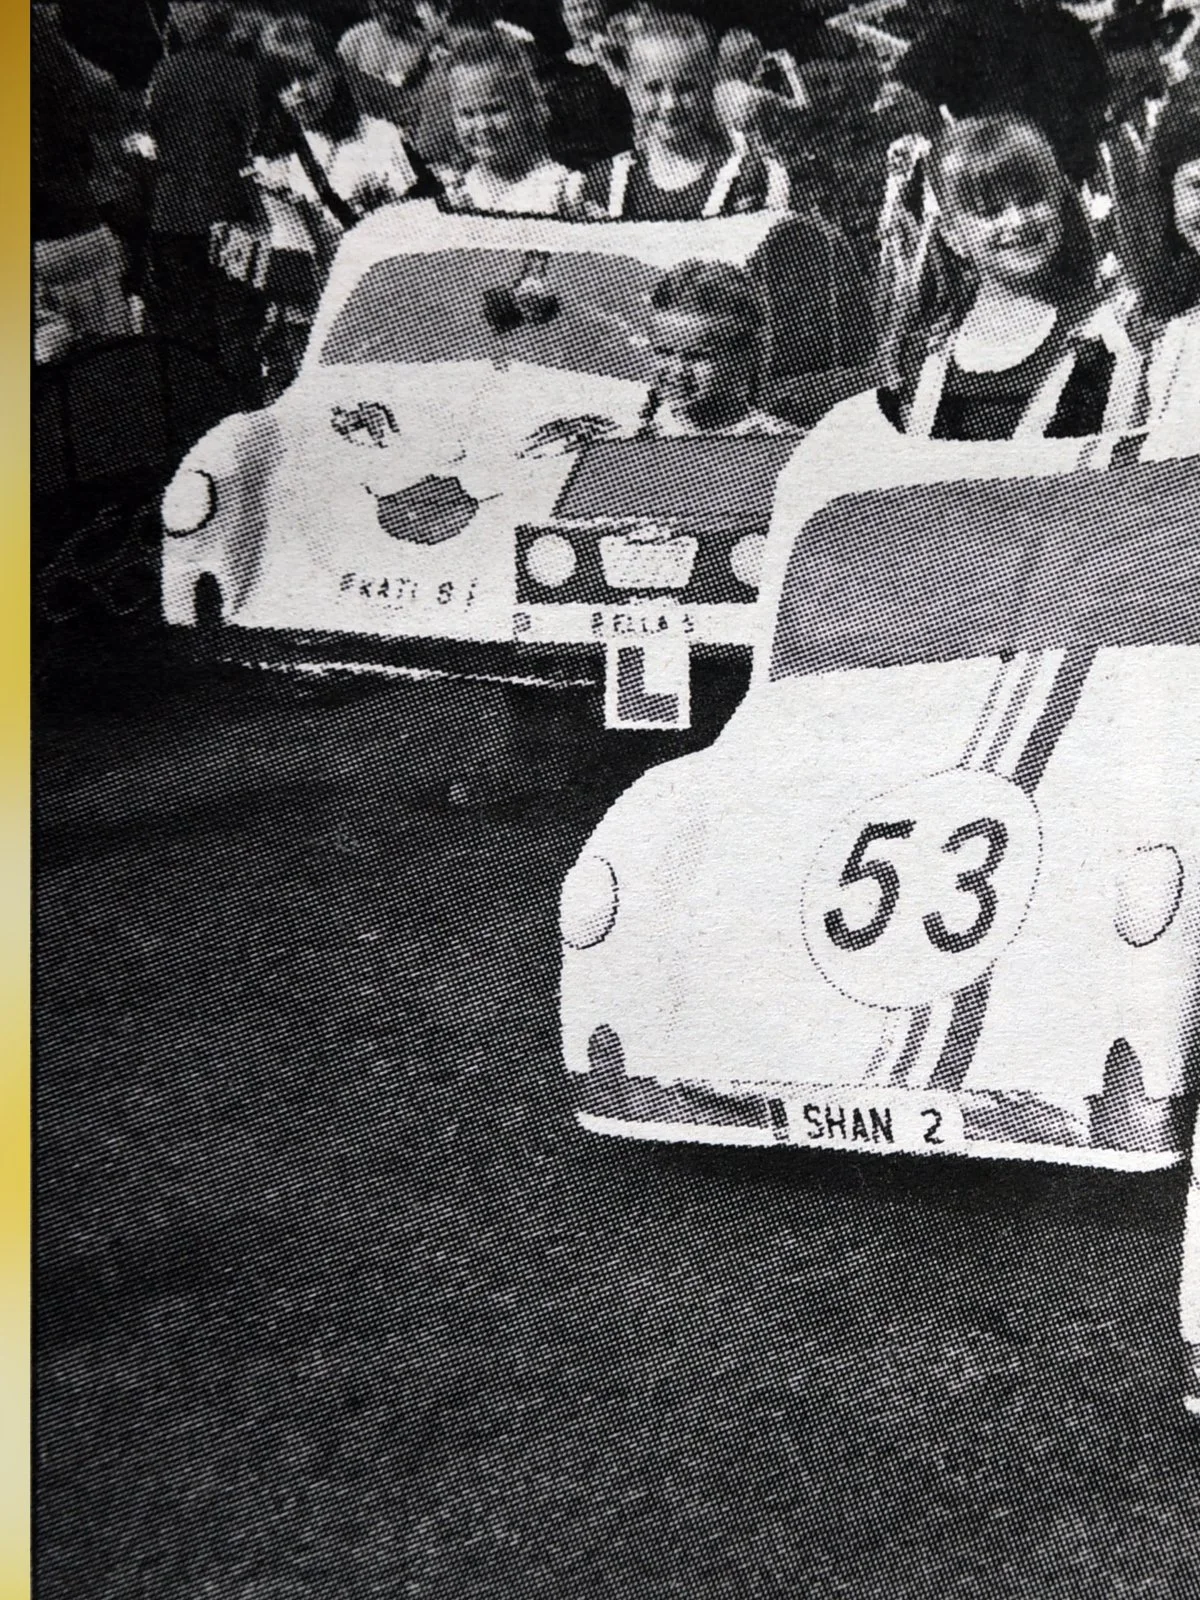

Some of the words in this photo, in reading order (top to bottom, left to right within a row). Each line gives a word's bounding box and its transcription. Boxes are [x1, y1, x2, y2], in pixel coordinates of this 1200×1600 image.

[616, 645, 679, 722] L
[823, 816, 1009, 954] 53
[802, 1102, 895, 1144] SHAN
[920, 1107, 945, 1145] 2
